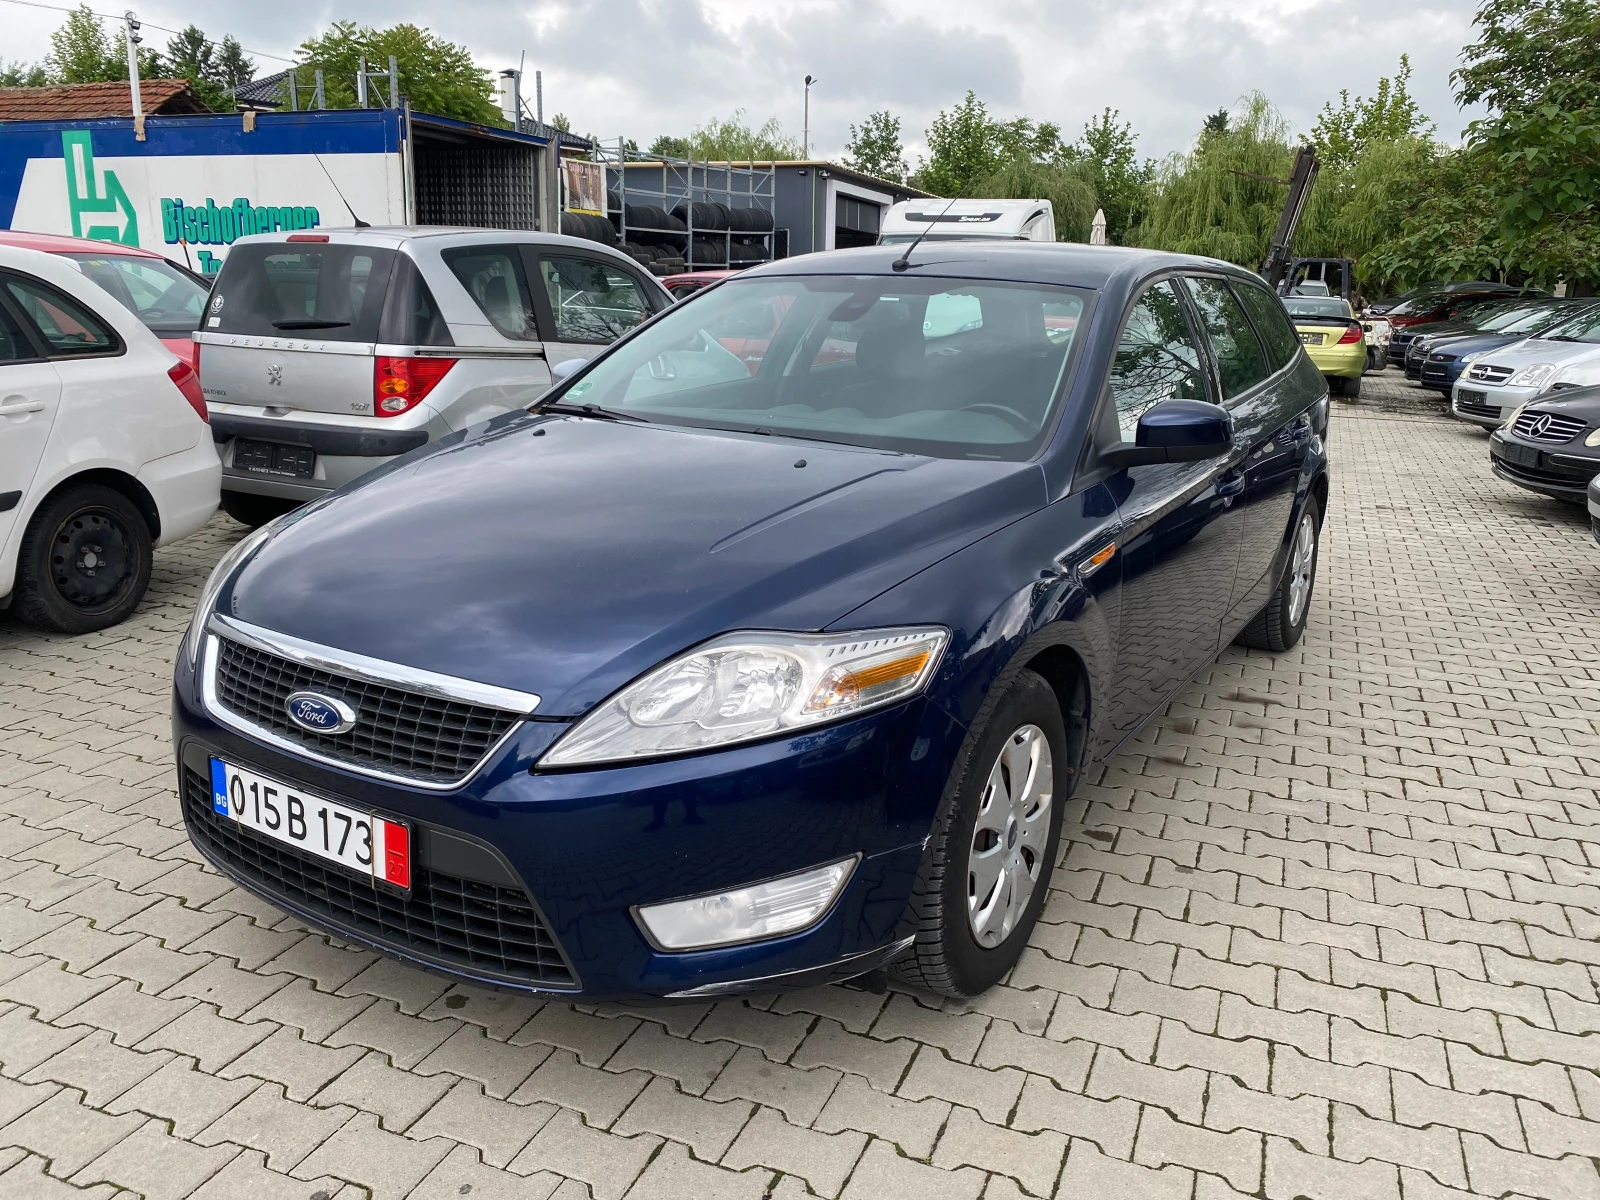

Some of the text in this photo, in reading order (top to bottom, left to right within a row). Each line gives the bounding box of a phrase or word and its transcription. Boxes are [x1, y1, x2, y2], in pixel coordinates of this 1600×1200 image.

[160, 198, 320, 245] Bischofberger
[230, 338, 325, 351] PEUGEOT
[350, 402, 370, 411] 1007
[297, 700, 329, 724] Ford
[215, 792, 227, 808] BG
[388, 860, 404, 878] 27
